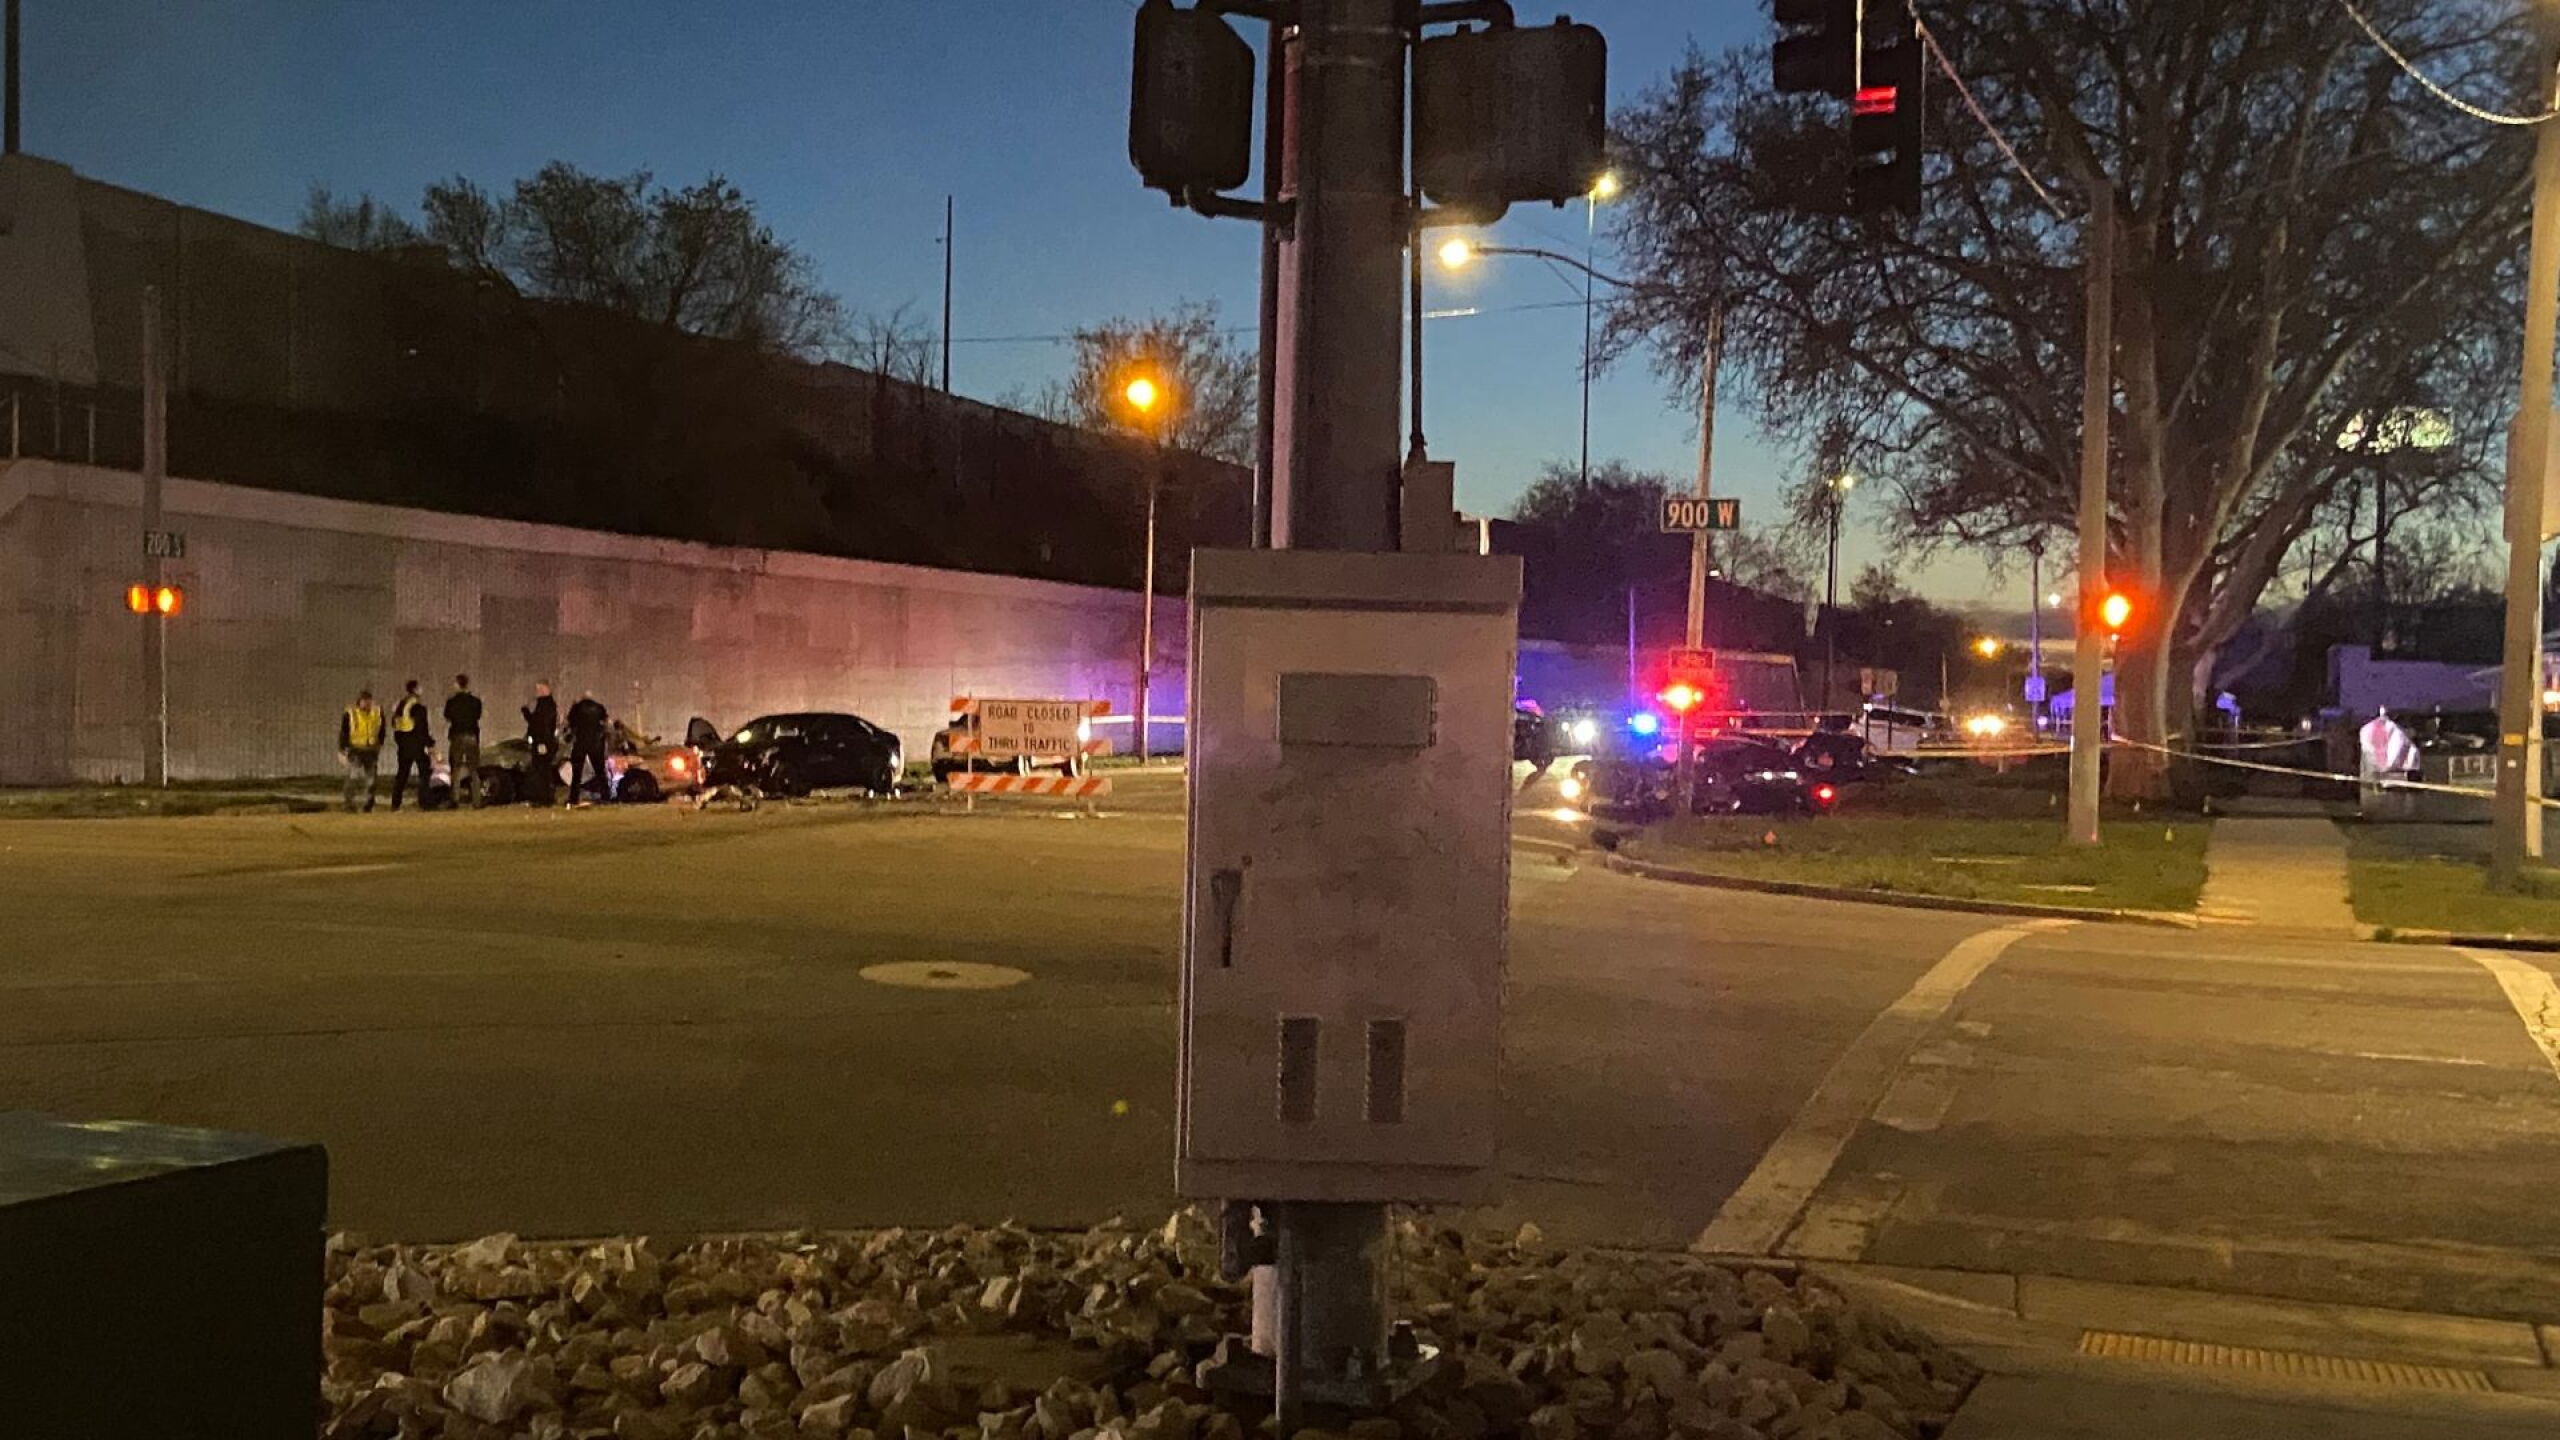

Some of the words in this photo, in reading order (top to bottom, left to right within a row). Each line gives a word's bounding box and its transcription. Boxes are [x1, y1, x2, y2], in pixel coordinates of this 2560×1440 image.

[1668, 502, 1708, 527] 900
[1717, 501, 1734, 528] W
[988, 705, 1017, 719] ROAD
[1027, 705, 1070, 720] CLOSED
[1023, 722, 1034, 734] TO
[988, 737, 1018, 750] THRU
[1024, 737, 1070, 751] TRAFFIC
